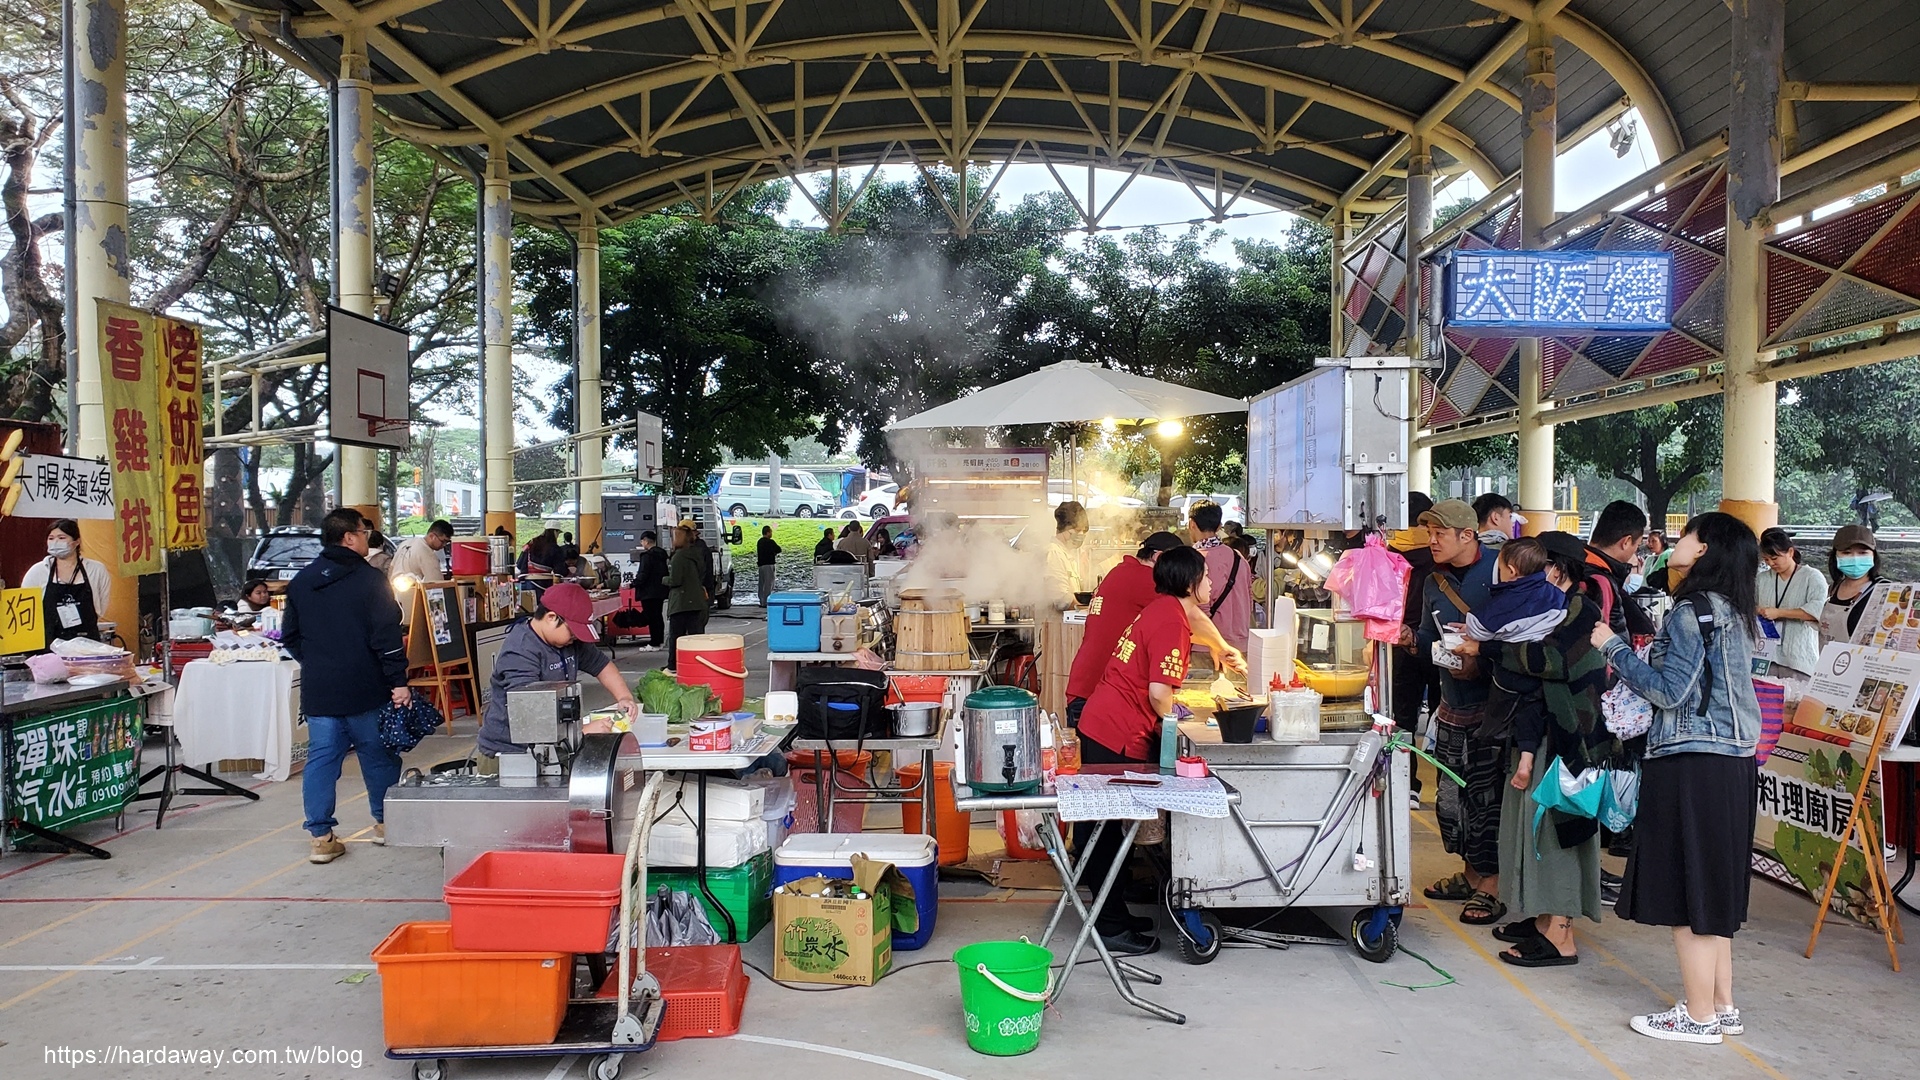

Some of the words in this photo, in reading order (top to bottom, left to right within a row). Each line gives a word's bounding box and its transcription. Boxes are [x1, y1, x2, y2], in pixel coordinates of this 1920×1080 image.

[1460, 257, 1664, 322] 大阪燒
[105, 316, 155, 564] 香雞排
[162, 321, 206, 544] 烤魷魚
[15, 462, 114, 507] 大腸麵線
[0, 593, 36, 640] 狗
[14, 720, 78, 780] 彈珠
[14, 770, 77, 822] 汽水
[1758, 772, 1856, 841] 料理廚房
